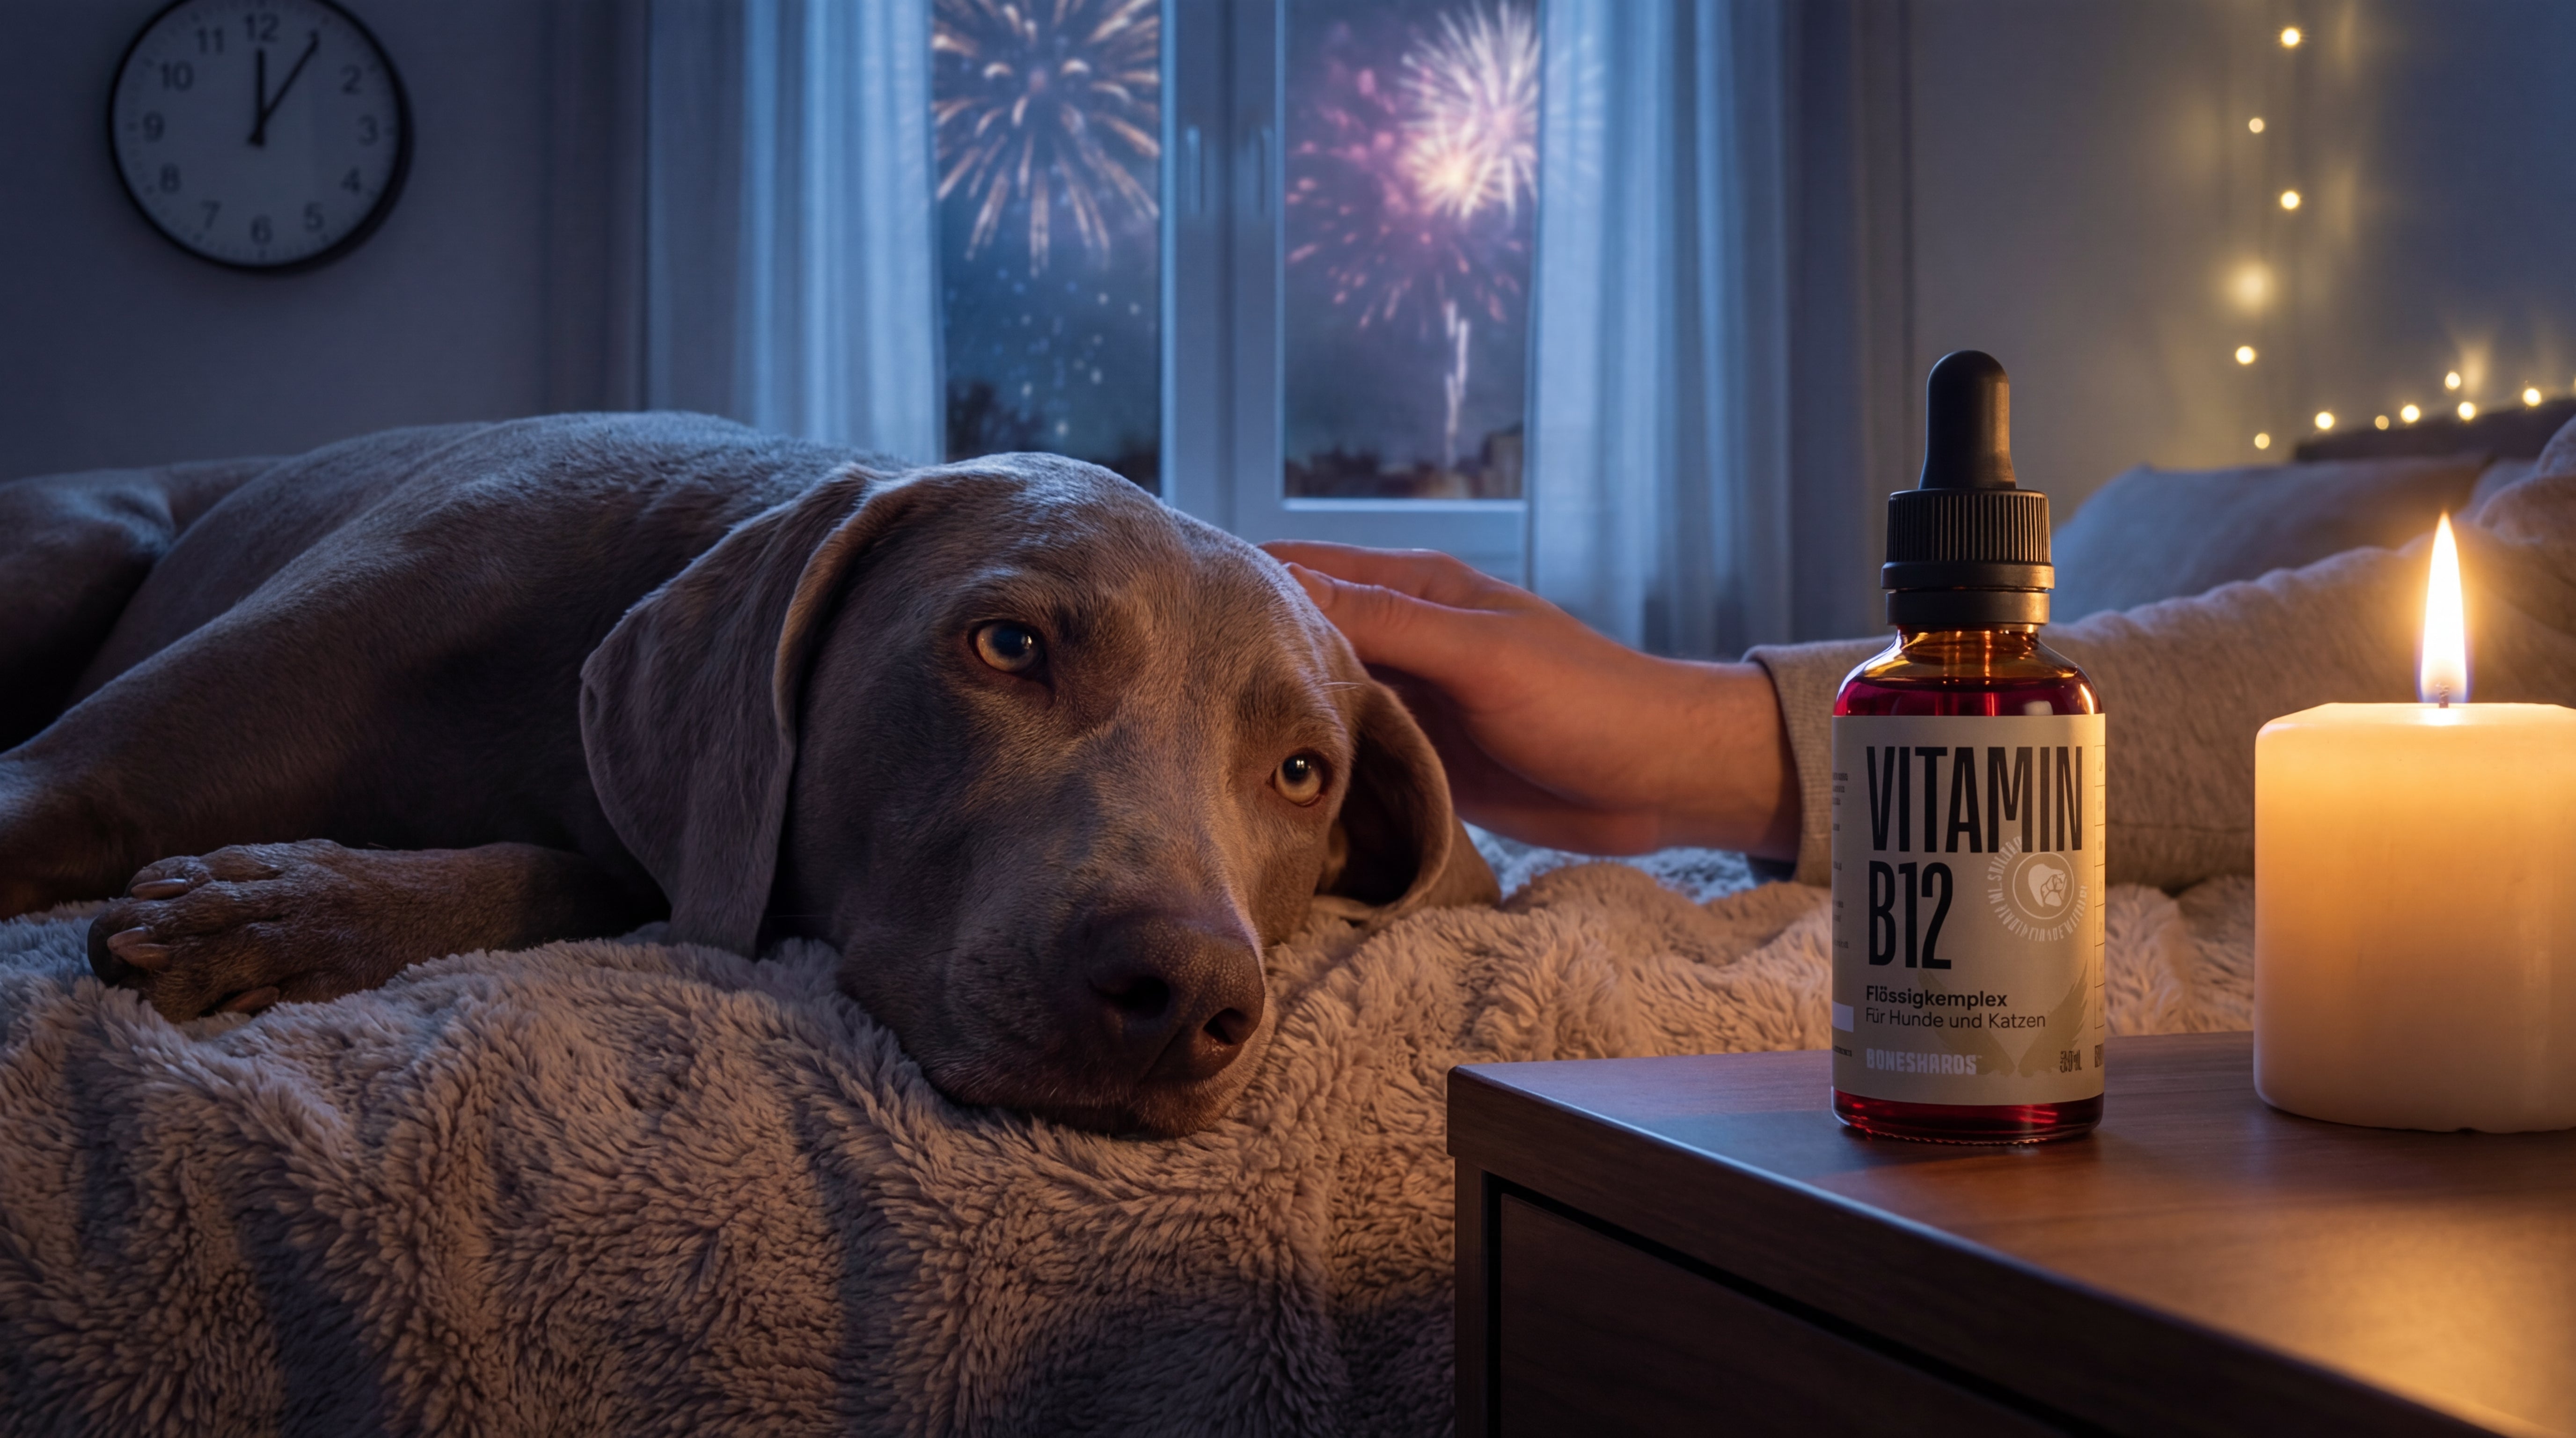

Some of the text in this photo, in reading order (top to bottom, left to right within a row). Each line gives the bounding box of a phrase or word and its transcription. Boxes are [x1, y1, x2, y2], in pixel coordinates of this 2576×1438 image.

[197, 26, 224, 54] 11
[244, 13, 278, 43] 12
[159, 60, 194, 91] 10
[341, 64, 362, 95] 2
[143, 110, 164, 142] 9
[358, 114, 378, 146] 3
[159, 163, 182, 194] 8
[340, 166, 360, 193] 4
[201, 200, 221, 229] 7
[250, 215, 272, 245] 6
[303, 202, 324, 233] 5
[1866, 746, 2083, 853] VITAMIN
[1868, 860, 1953, 970] B12
[1866, 985, 2008, 1011] Flössigkemplex
[1866, 1007, 2046, 1028] Für Hunde und Katzen
